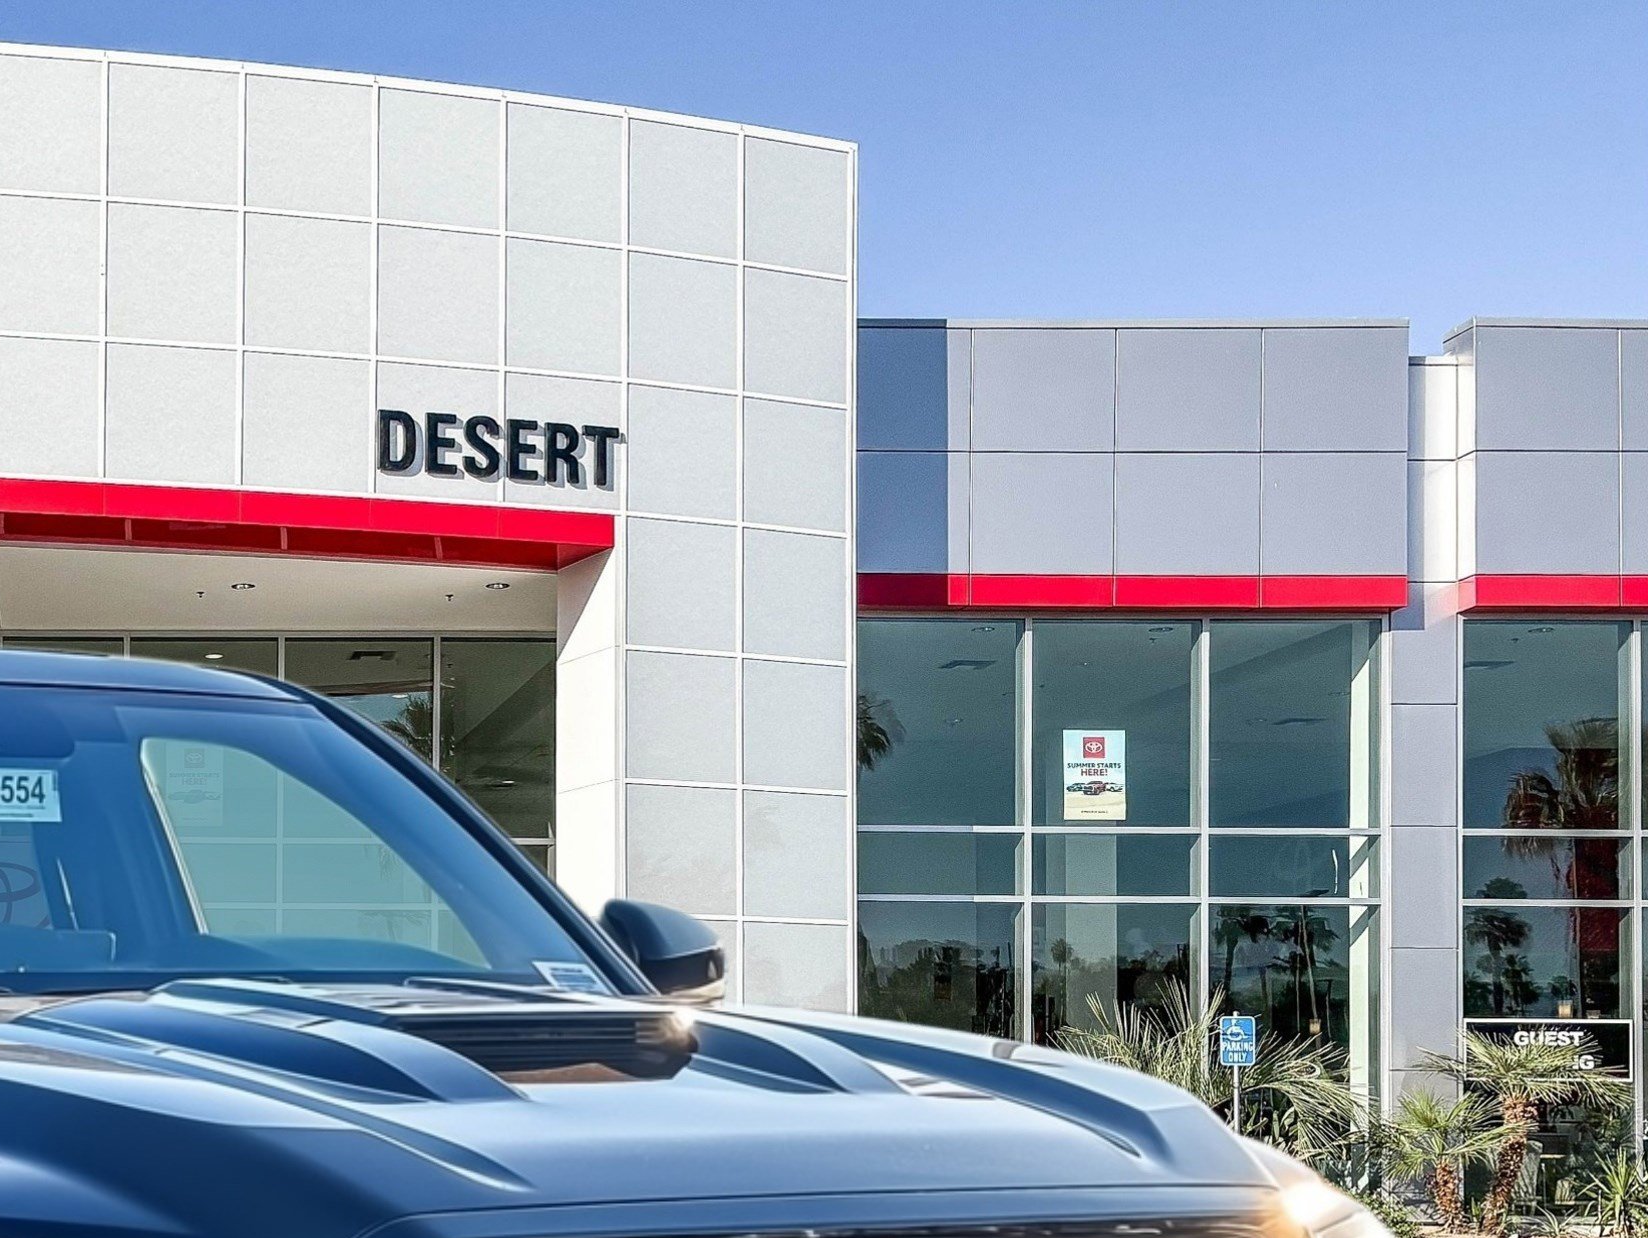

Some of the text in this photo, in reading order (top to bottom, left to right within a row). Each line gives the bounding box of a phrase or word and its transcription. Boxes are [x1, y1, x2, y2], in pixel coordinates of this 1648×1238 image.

[377, 409, 619, 486] DESERT
[1513, 1031, 1584, 1046] GUEST
[1222, 1041, 1253, 1052] PARKING
[1228, 1052, 1247, 1062] ONLY
